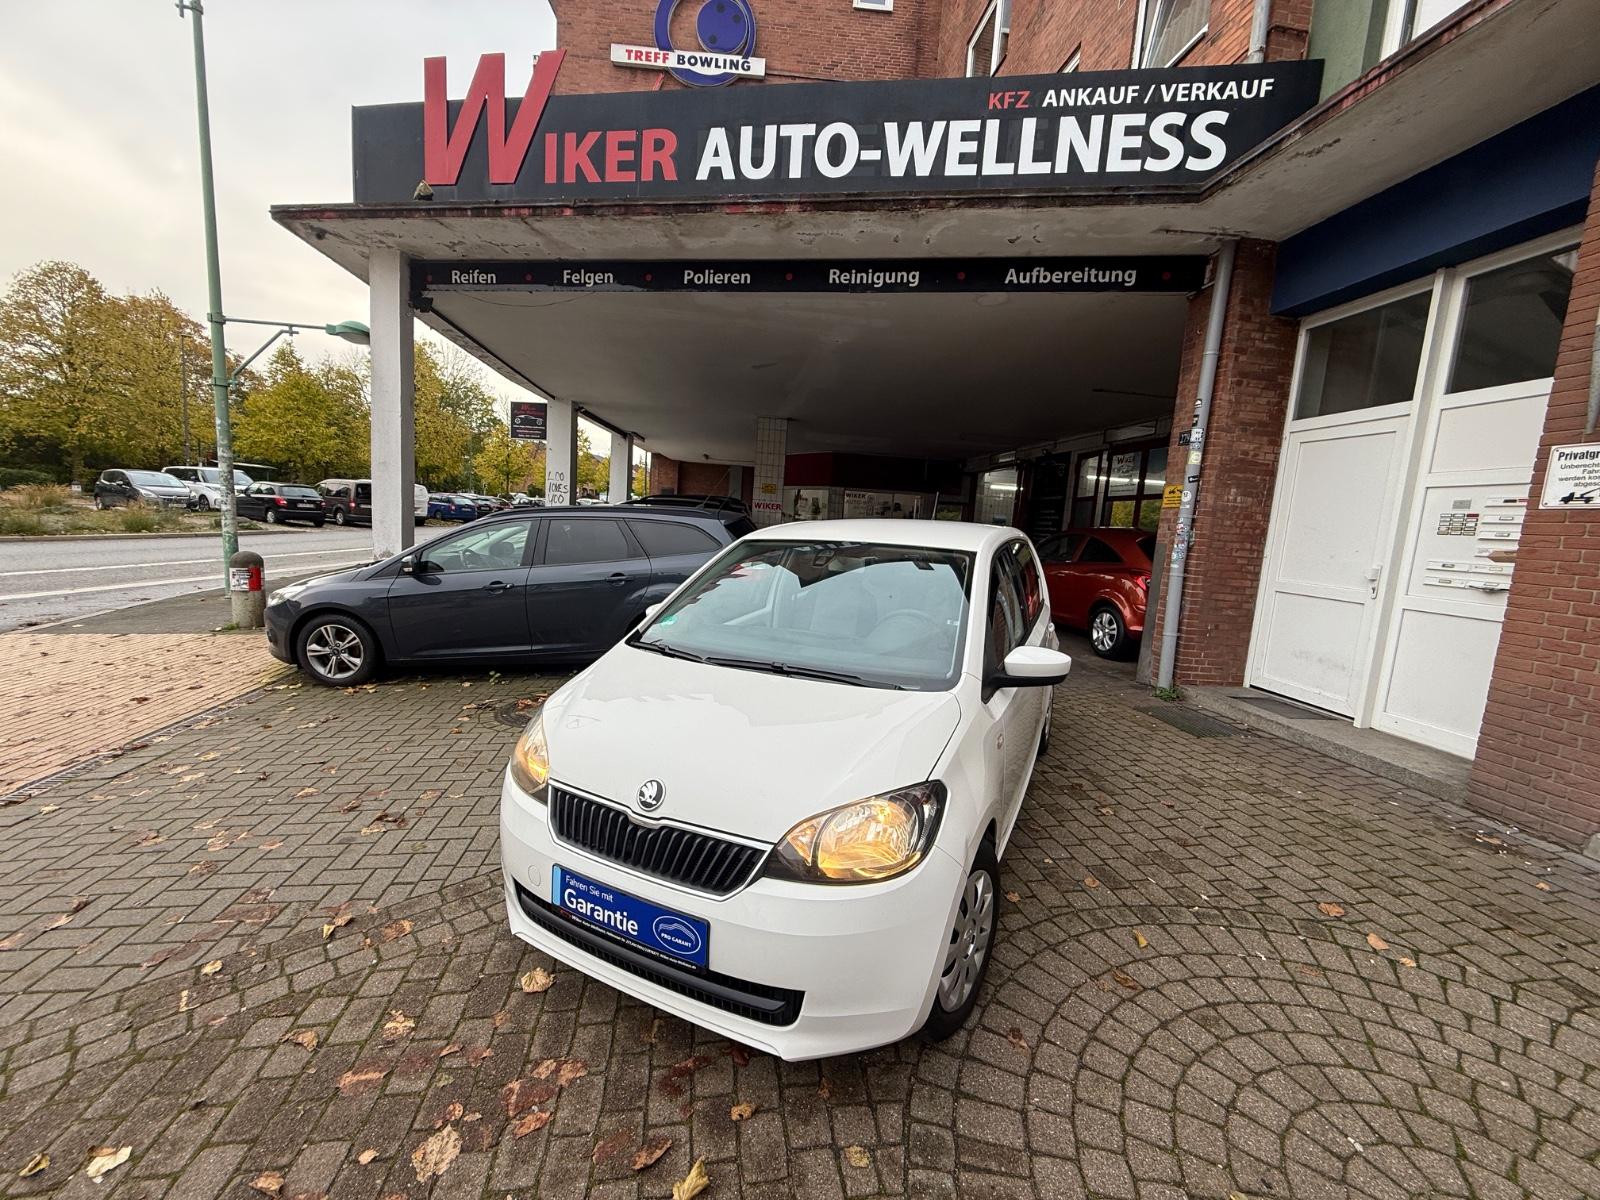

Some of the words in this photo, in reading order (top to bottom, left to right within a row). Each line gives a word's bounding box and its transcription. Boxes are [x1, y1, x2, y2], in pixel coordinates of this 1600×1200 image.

[625, 48, 670, 65] TREFF
[676, 53, 752, 72] BOWLING
[987, 90, 1030, 110] KFZ
[1042, 85, 1140, 108] ANKAUF
[1158, 78, 1276, 103] VERKAUF
[695, 110, 1230, 181] AUTO-WELLNESS
[451, 270, 497, 284] Reifen
[563, 270, 614, 287] Felgen
[683, 270, 752, 285] Polieren
[828, 268, 921, 287] Reinigung
[1005, 266, 1138, 286] Aufbereitung
[754, 502, 782, 510] WIKER
[565, 875, 588, 892] Fahren
[589, 885, 600, 897] Sie
[601, 892, 613, 902] mit
[564, 888, 638, 935] Garantie
